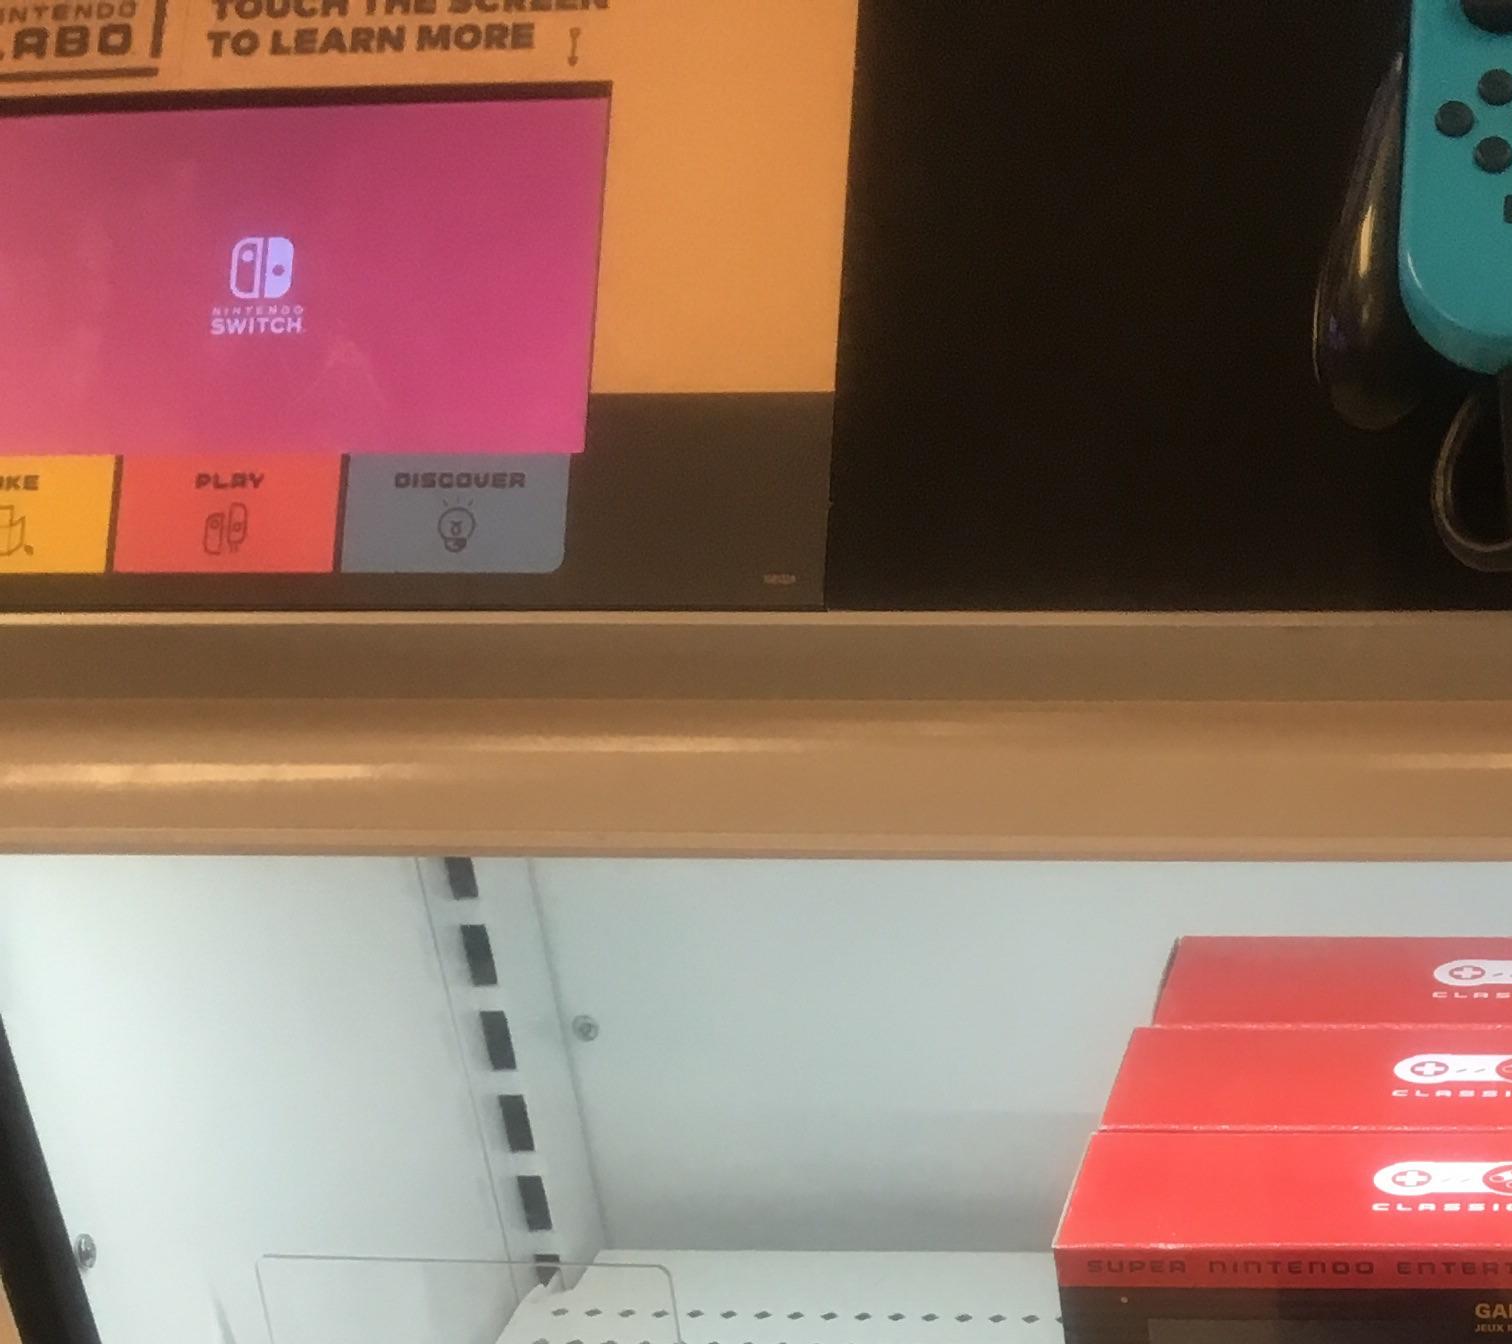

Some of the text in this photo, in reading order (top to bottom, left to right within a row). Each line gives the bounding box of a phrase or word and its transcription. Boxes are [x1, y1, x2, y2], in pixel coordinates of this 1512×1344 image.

[0, 3, 136, 25] INTENDO
[0, 23, 133, 60] ABO
[207, 22, 535, 57] TO LEARN MORE
[212, 304, 304, 316] NINTENDO
[210, 317, 303, 335] SWITCH
[0, 474, 39, 491] KE
[194, 472, 265, 489] PLAY
[394, 472, 526, 489] DISCOVER
[1086, 1259, 1187, 1274] SUPER
[1208, 1260, 1375, 1275] NINTENDO
[1474, 1323, 1504, 1333] JEUX
